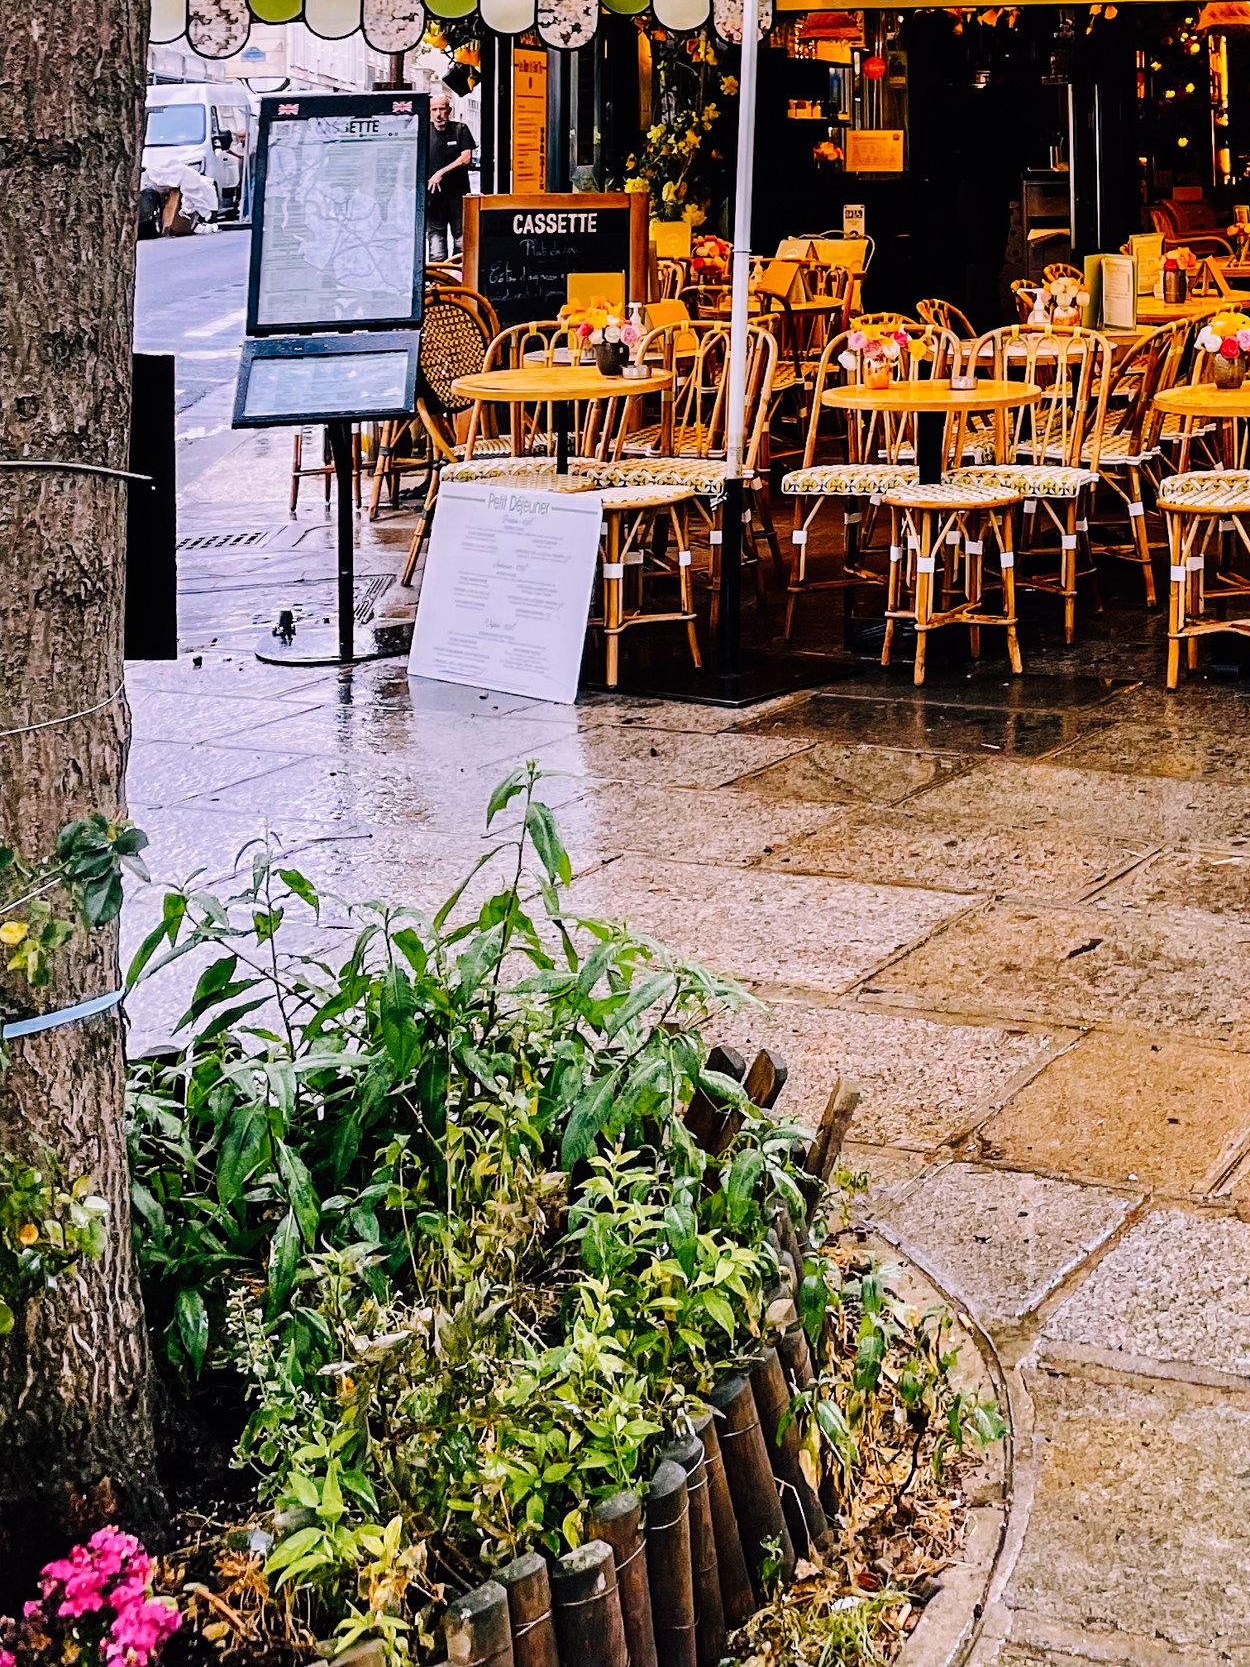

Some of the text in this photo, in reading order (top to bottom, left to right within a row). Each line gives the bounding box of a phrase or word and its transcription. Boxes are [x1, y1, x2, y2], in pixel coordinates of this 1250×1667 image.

[512, 212, 598, 235] CASSETTE
[487, 492, 551, 516] Petit Déjeuner
